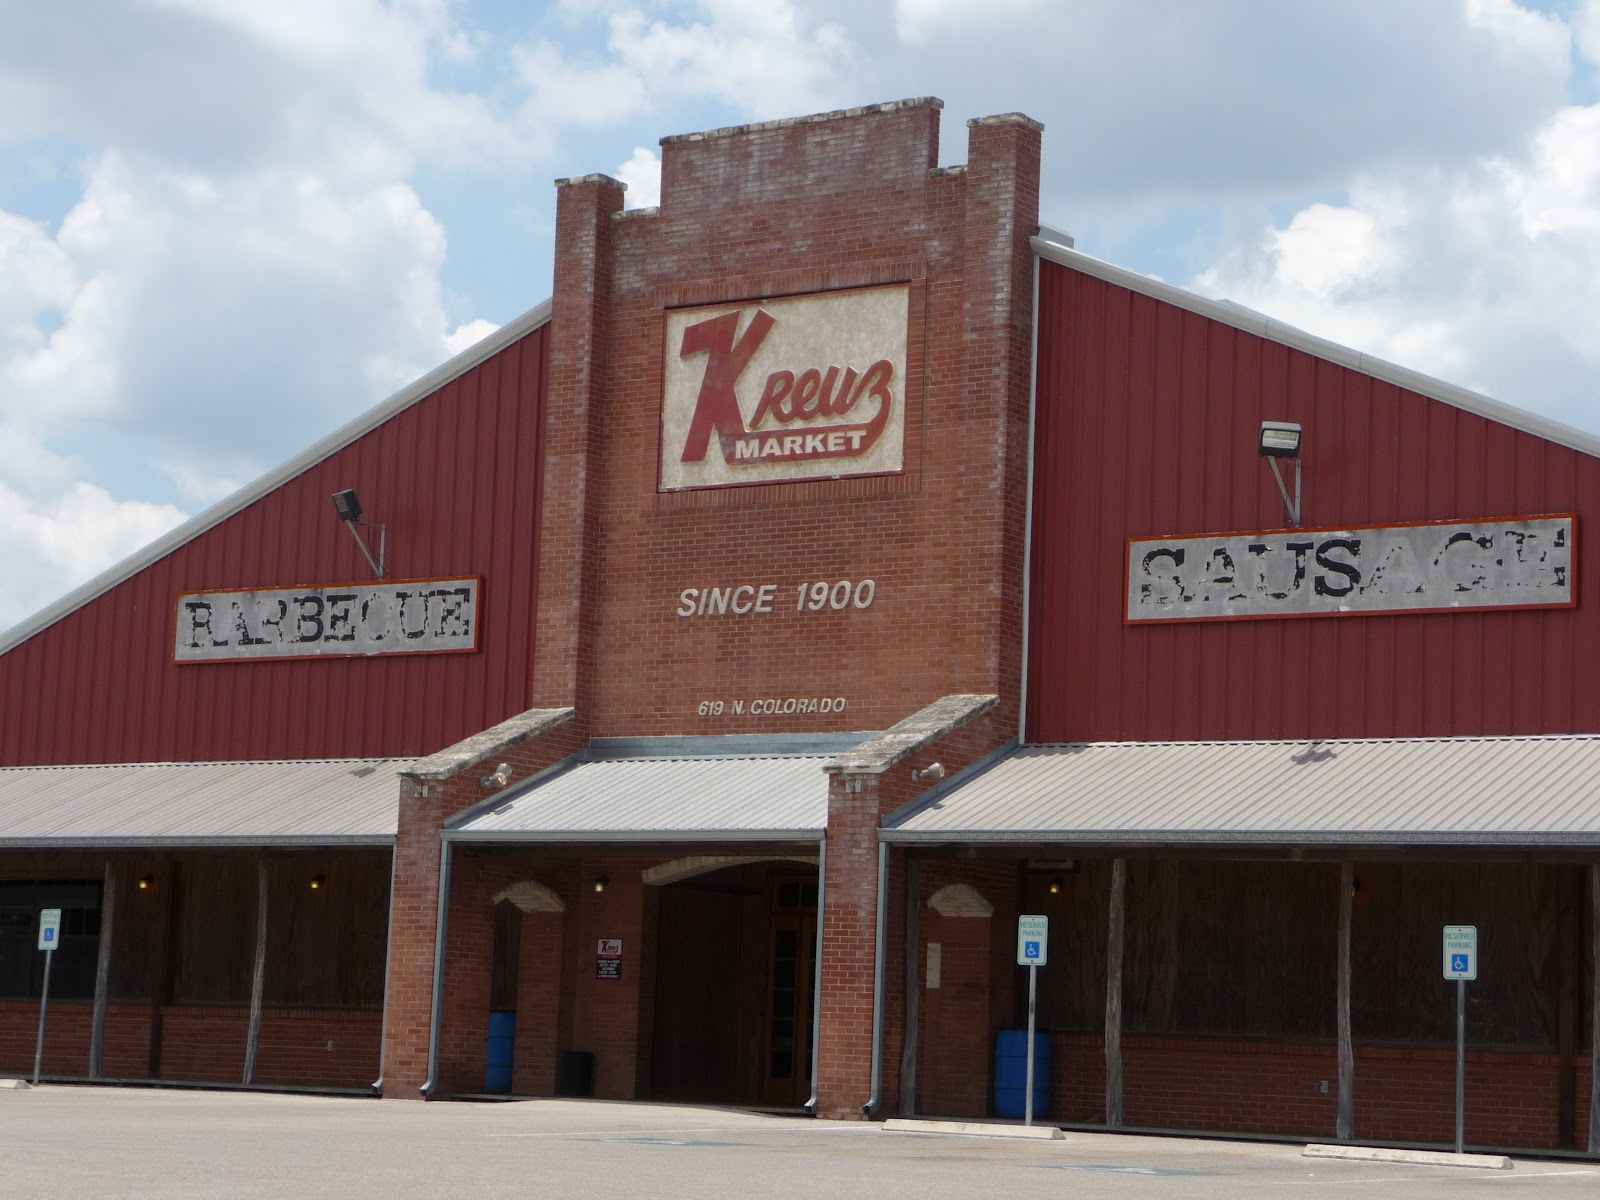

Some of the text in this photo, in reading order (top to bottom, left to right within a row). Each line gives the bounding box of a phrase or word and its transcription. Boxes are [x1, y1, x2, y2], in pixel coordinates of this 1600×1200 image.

[680, 308, 894, 464] Kreuz
[735, 430, 867, 459] MARKET
[677, 579, 875, 617] SINCE 1900
[698, 698, 846, 716] 619 N. COLORADO
[1445, 932, 1474, 940] RESERVED
[1447, 941, 1472, 949] PARKING
